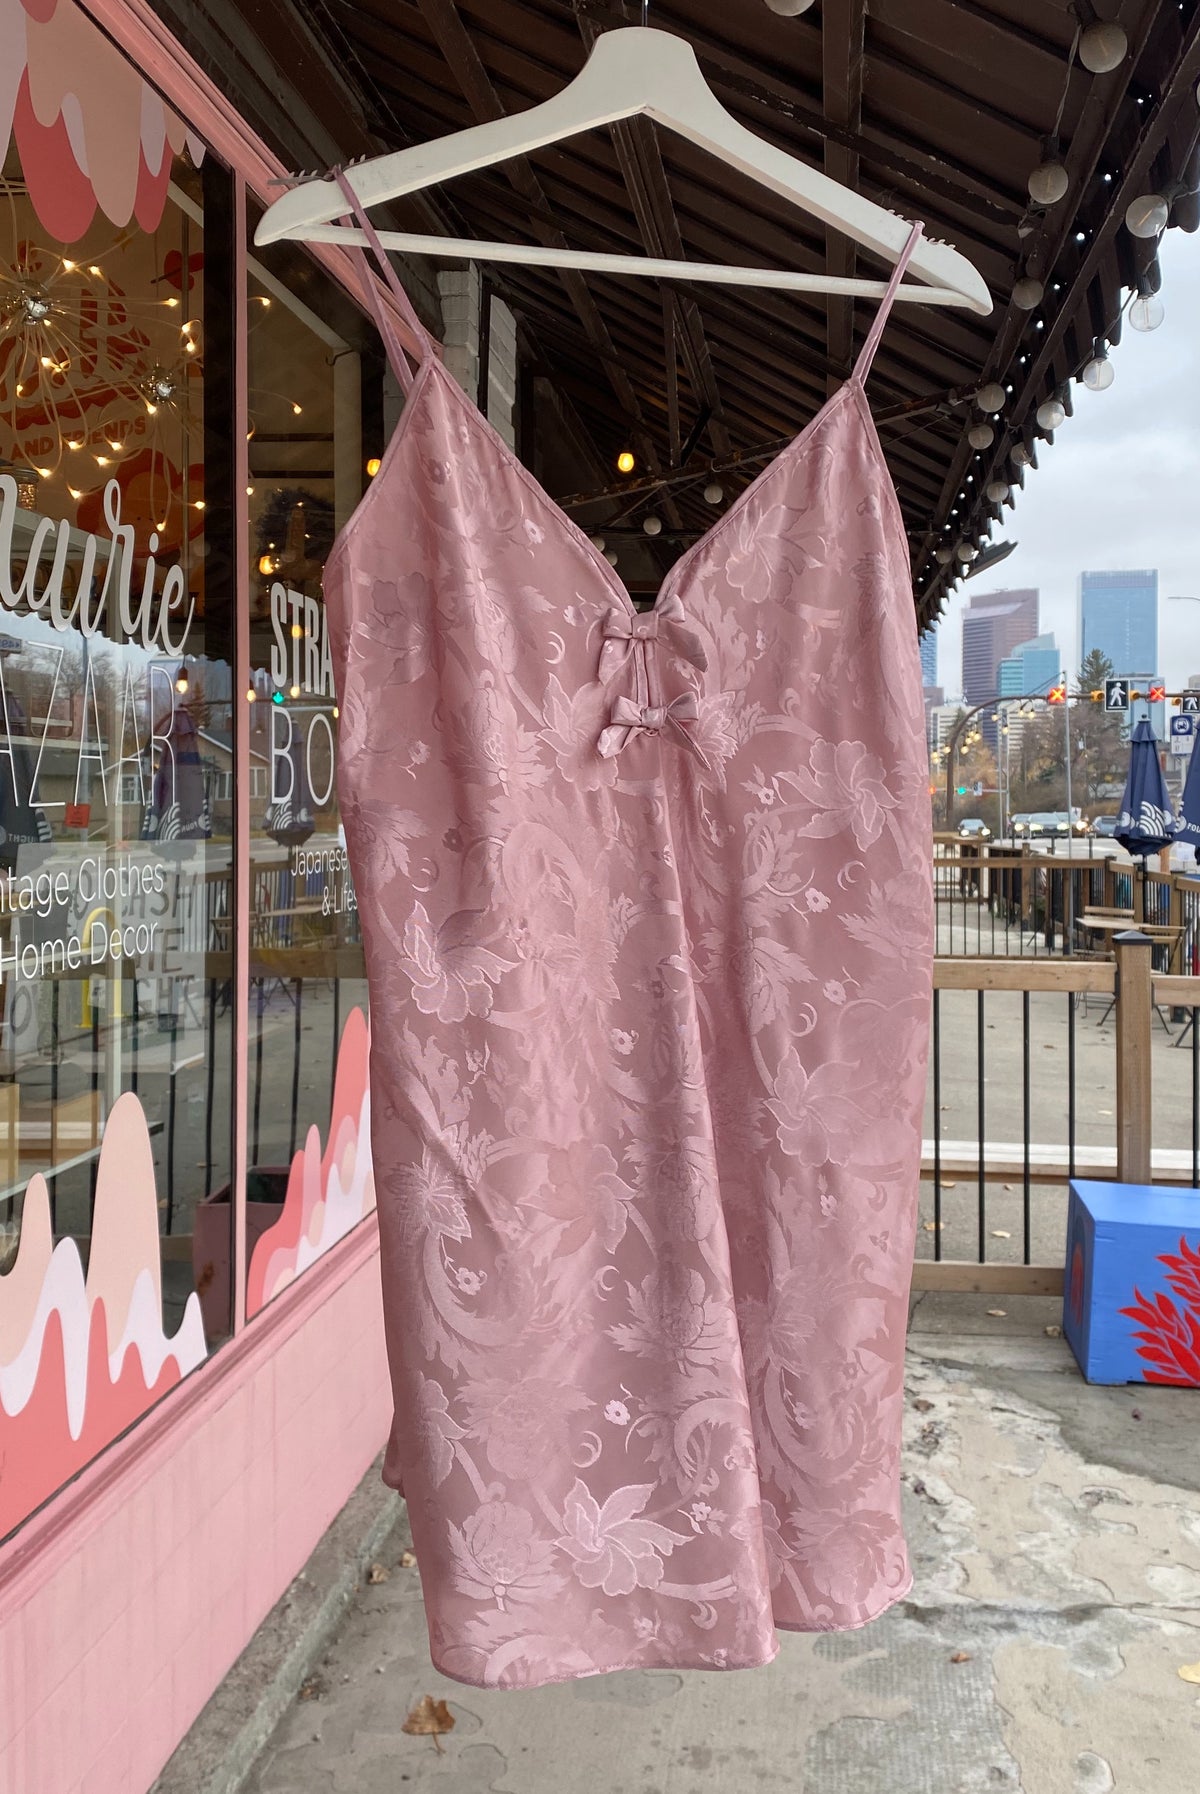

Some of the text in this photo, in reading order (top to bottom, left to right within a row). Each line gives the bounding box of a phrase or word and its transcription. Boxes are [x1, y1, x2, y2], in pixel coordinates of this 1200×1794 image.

[10, 436, 54, 461] AND
[271, 705, 335, 806] BO
[79, 854, 164, 902] Clothes
[291, 845, 348, 881] Japanese
[322, 886, 331, 916] &
[0, 921, 158, 984] Home Decor
